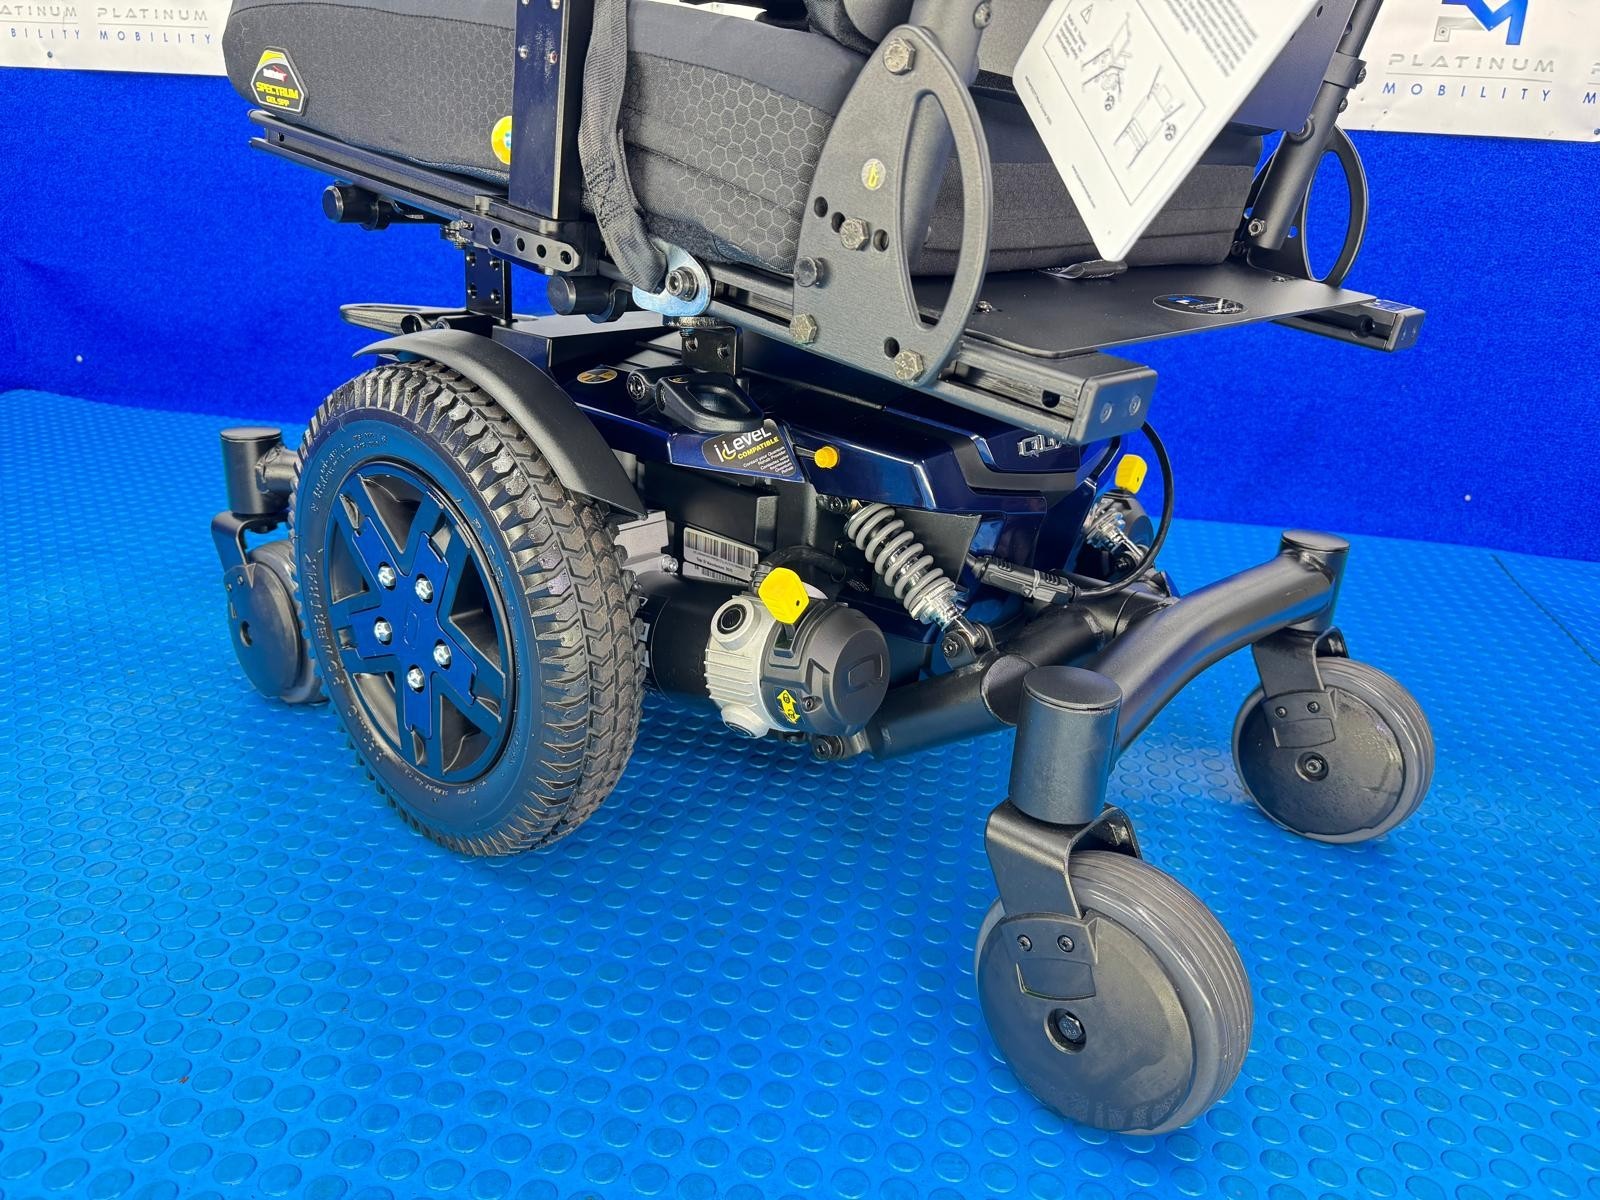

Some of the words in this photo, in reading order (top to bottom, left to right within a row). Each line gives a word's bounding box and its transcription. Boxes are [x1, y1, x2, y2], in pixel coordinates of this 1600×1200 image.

[97, 7, 208, 21] PLATINUM
[99, 30, 211, 44] MOBILITY
[1388, 53, 1555, 73] PLATINUM
[255, 81, 299, 99] SPECTRUM
[1382, 82, 1551, 102] MOBILITY
[736, 436, 779, 459] COMPATIBLE
